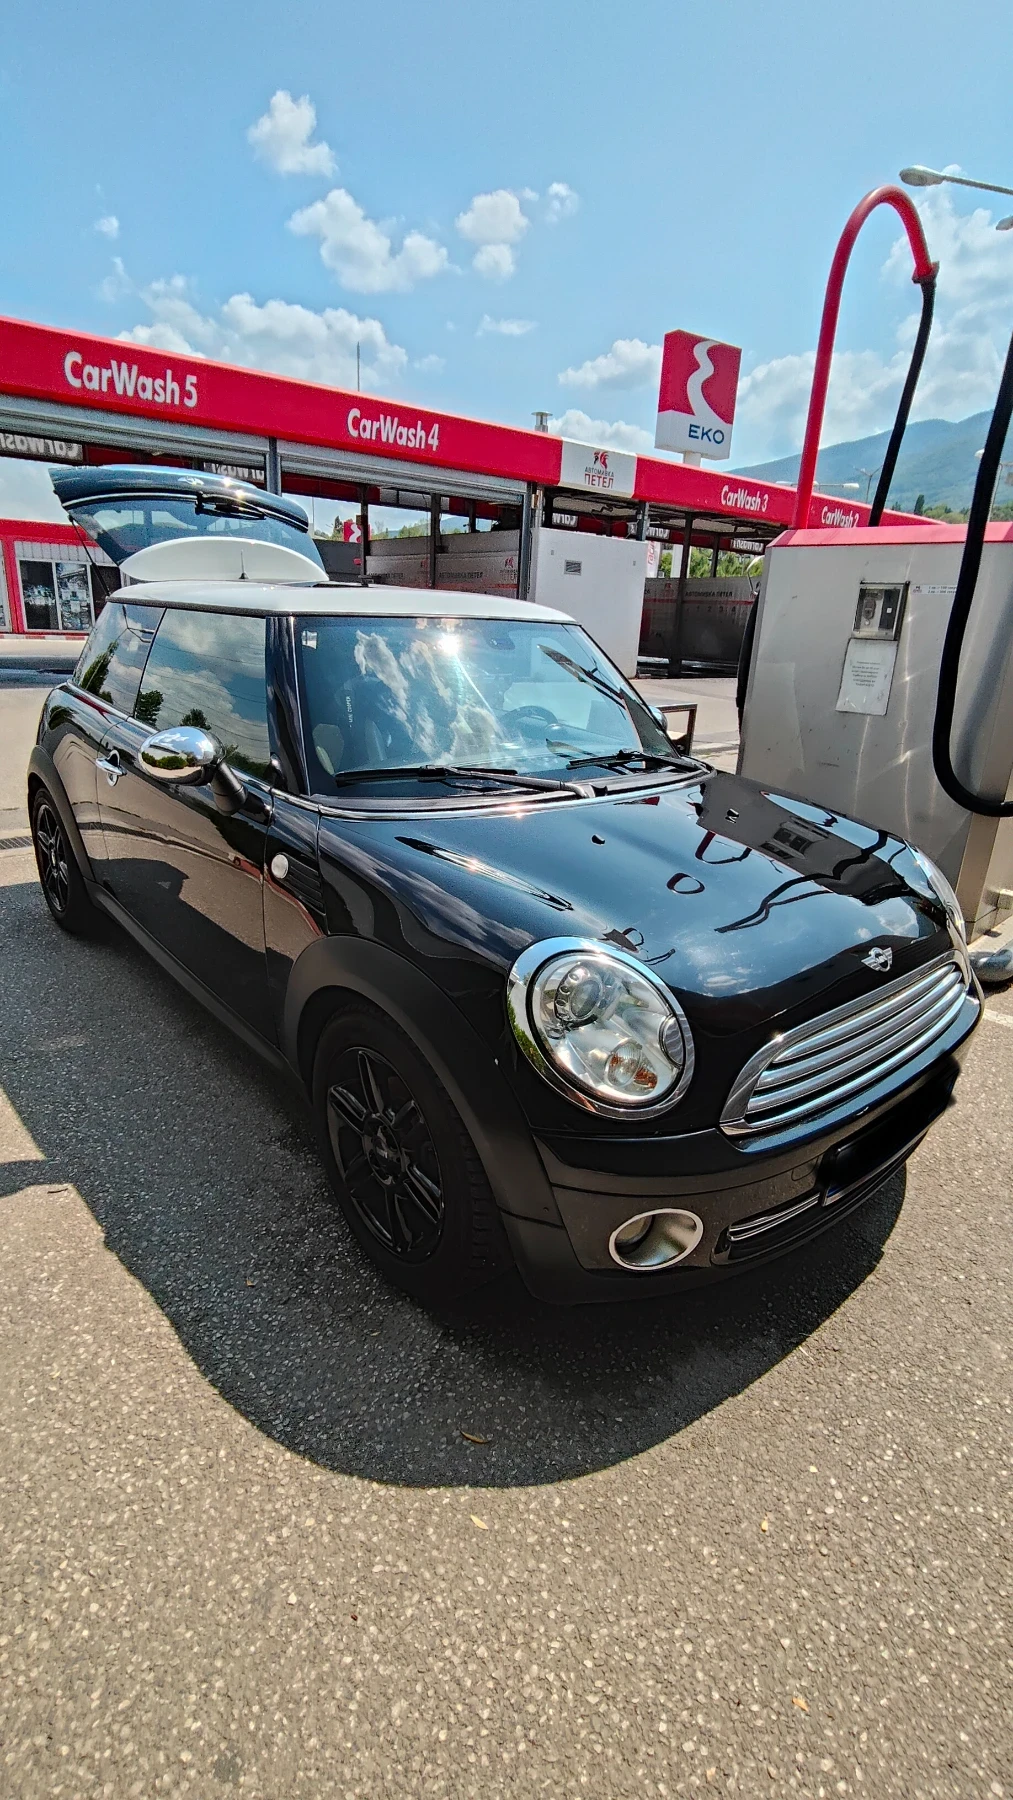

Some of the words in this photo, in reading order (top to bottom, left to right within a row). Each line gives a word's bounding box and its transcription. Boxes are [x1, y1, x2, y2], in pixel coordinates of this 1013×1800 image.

[64, 351, 180, 405] CarWash
[183, 374, 198, 408] 5
[347, 408, 426, 449] CarWash
[427, 423, 440, 452] 4
[688, 423, 725, 445] EKO
[584, 466, 615, 478] АВТОМИВКА
[584, 473, 614, 489] ПЕТЕЛ
[721, 485, 761, 511] CarWash
[761, 493, 769, 512] 3
[821, 506, 853, 527] CarWash
[853, 513, 860, 527] 2
